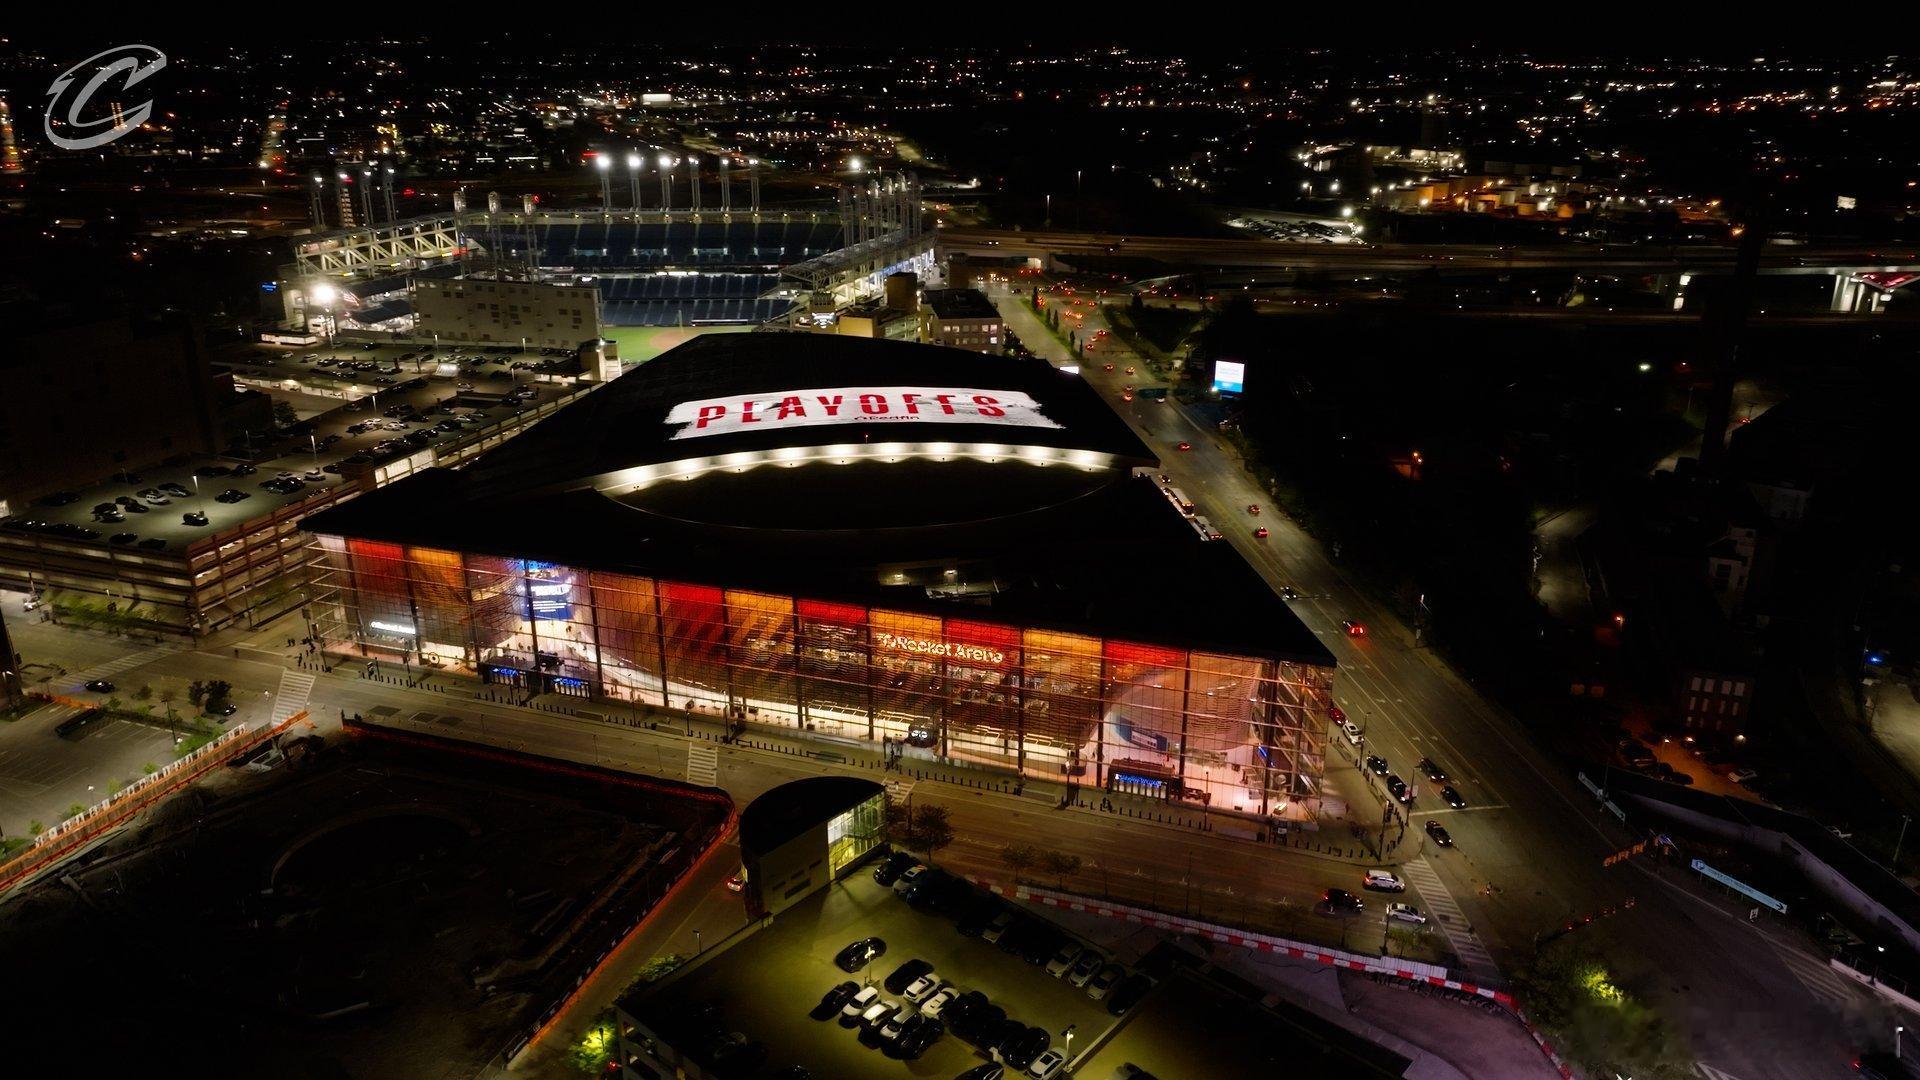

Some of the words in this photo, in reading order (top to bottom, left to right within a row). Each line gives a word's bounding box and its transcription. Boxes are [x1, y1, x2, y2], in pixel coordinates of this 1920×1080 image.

[697, 393, 1007, 428] PLAYOFFS
[898, 636, 952, 657] Rocket
[954, 644, 1004, 664] Arena
